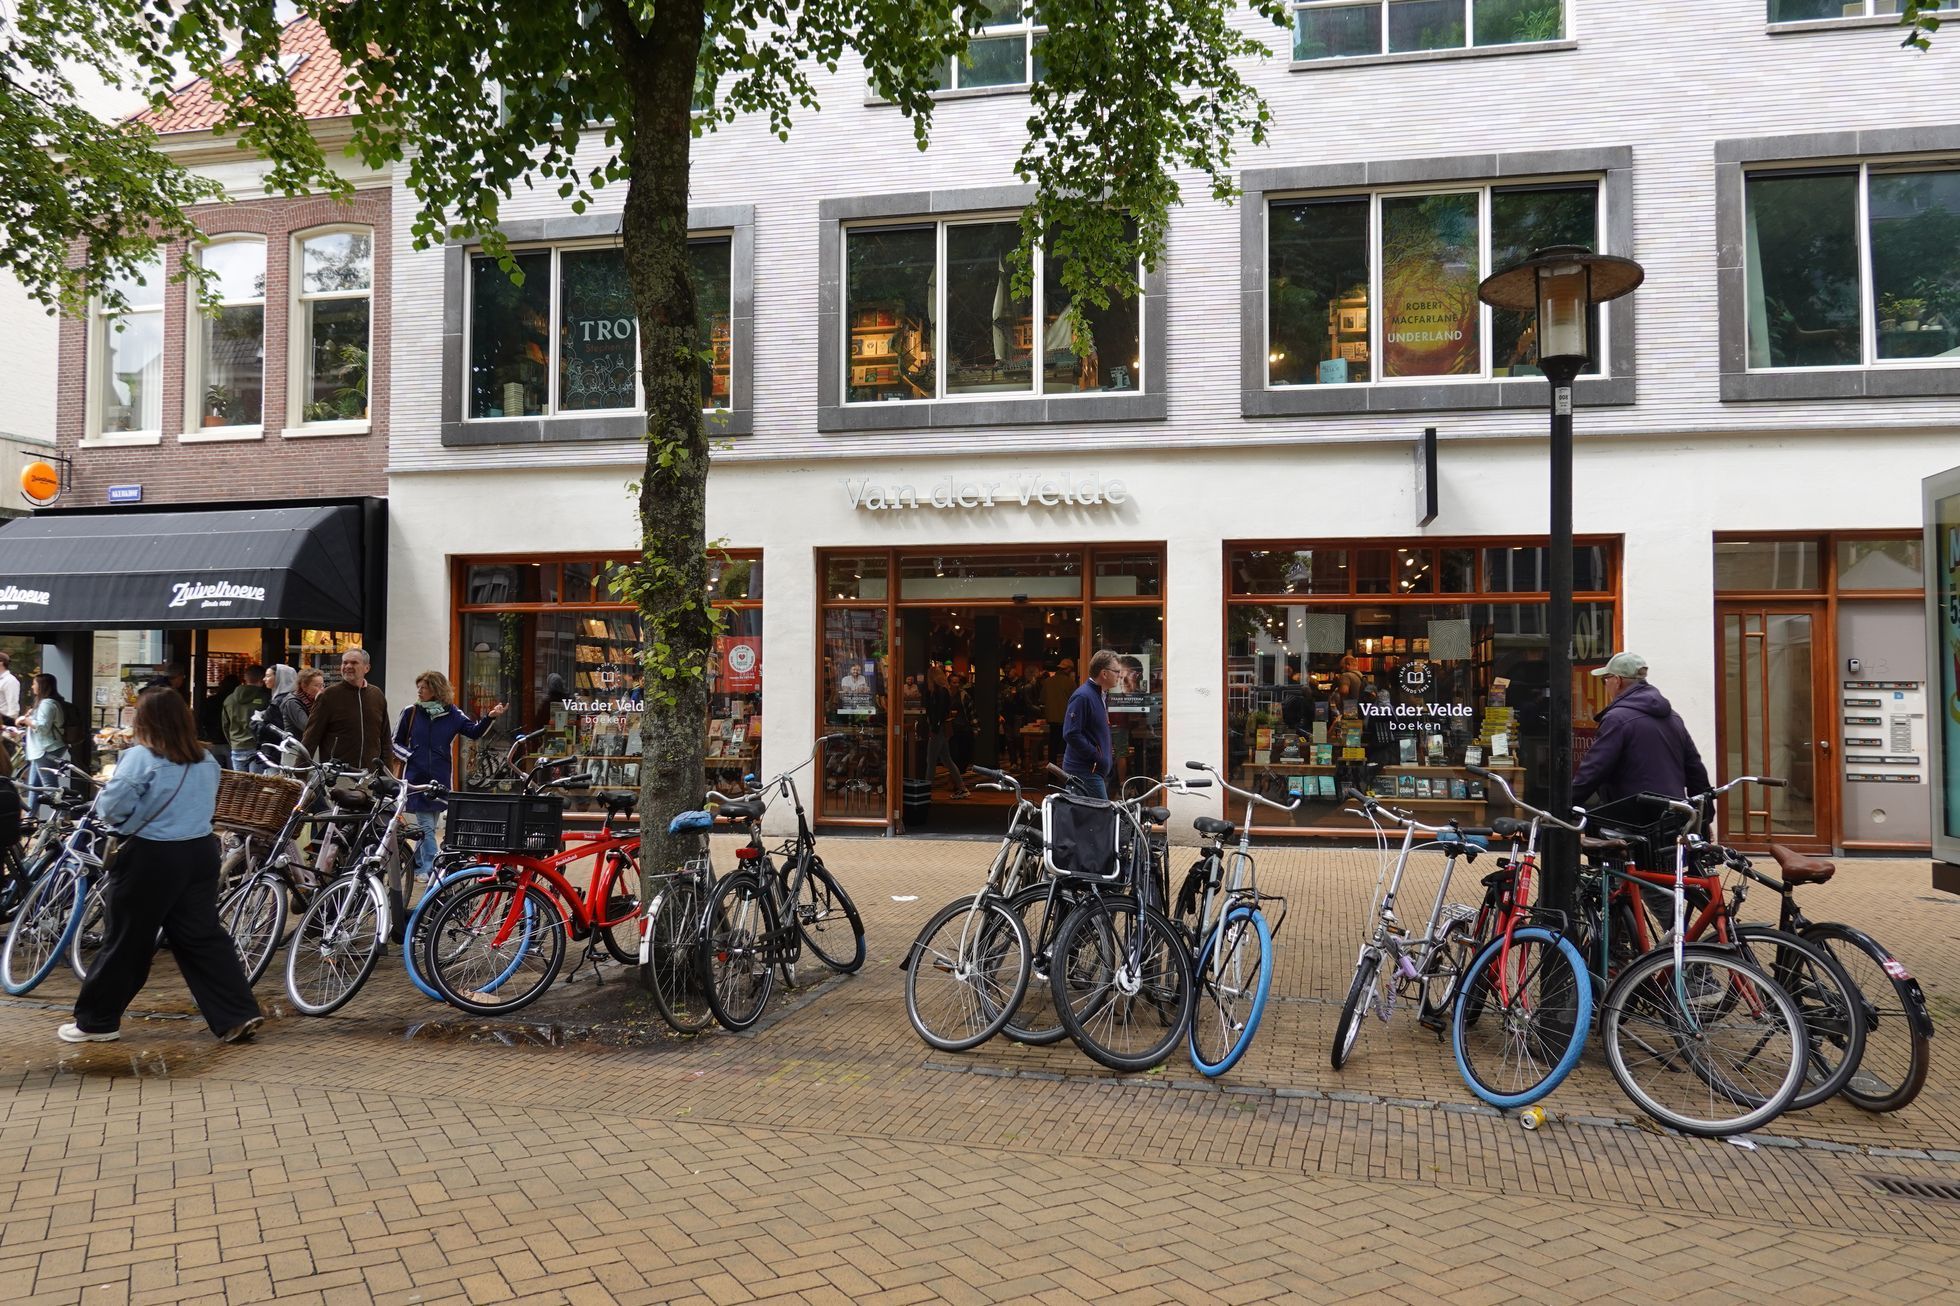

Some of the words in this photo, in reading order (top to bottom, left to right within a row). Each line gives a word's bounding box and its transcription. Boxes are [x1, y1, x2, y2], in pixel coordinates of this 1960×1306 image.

[1406, 301, 1442, 310] ROBERT
[1391, 314, 1457, 324] MACFARLANE
[1387, 330, 1462, 343] UNDERLAND
[840, 477, 919, 511] Van
[930, 475, 1000, 508] der
[1009, 471, 1127, 507] Velde
[168, 581, 265, 607] Zuivelhoeve
[562, 699, 588, 711] Van
[591, 699, 613, 712] der
[616, 700, 645, 712] Veld
[1359, 703, 1392, 717] Van
[1395, 703, 1424, 717] der
[1426, 703, 1473, 717] Velde
[585, 715, 627, 724] boeken
[1389, 721, 1441, 731] boeken
